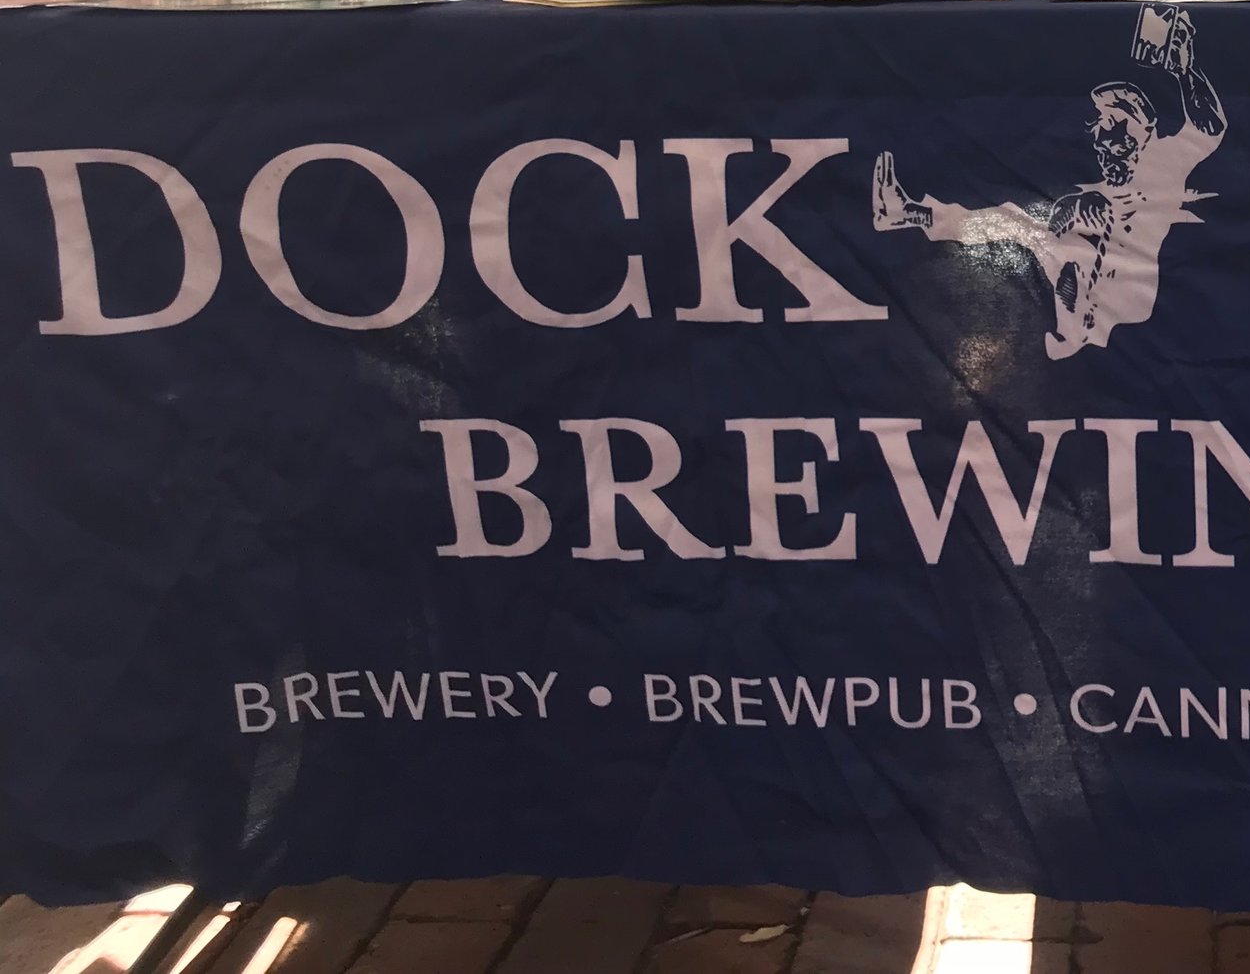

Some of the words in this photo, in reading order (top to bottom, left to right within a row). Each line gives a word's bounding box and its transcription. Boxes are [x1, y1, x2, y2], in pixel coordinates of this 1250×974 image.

[10, 135, 890, 336] DOCK
[234, 669, 559, 735] BREWERY
[646, 672, 982, 731] BREWPUB
